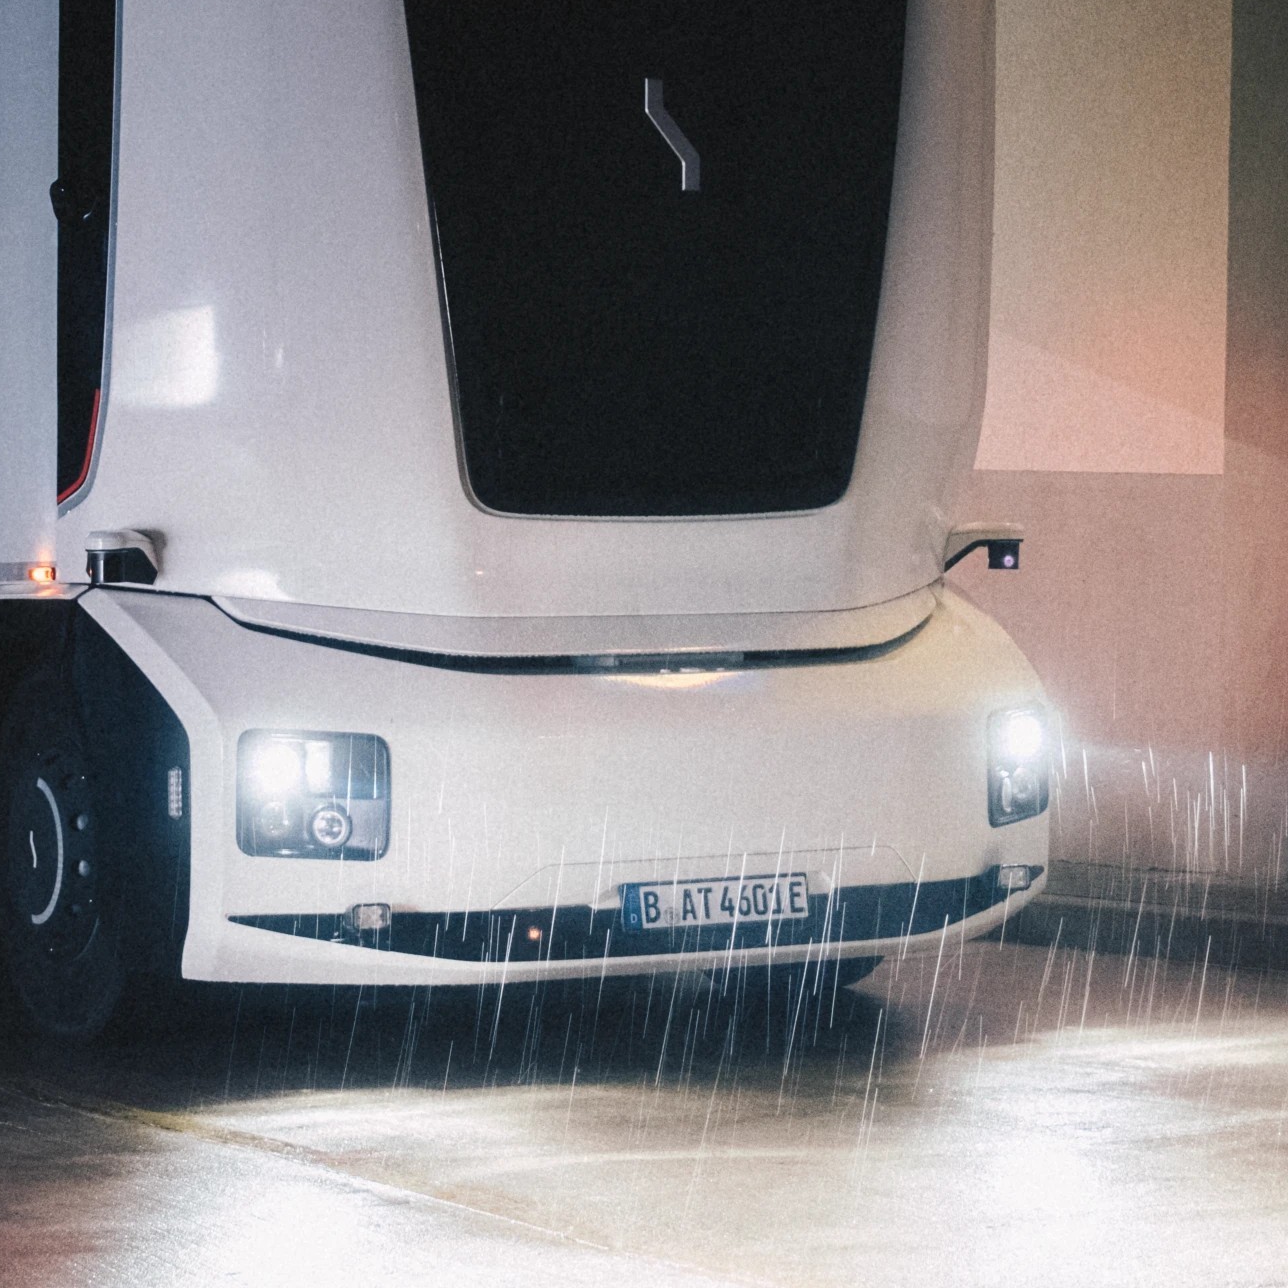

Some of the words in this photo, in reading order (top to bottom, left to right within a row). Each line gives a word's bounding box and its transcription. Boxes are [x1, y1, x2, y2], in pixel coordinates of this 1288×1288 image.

[643, 891, 661, 924] B
[682, 887, 712, 921] AT
[720, 881, 805, 918] 4601E
[630, 913, 638, 923] D
